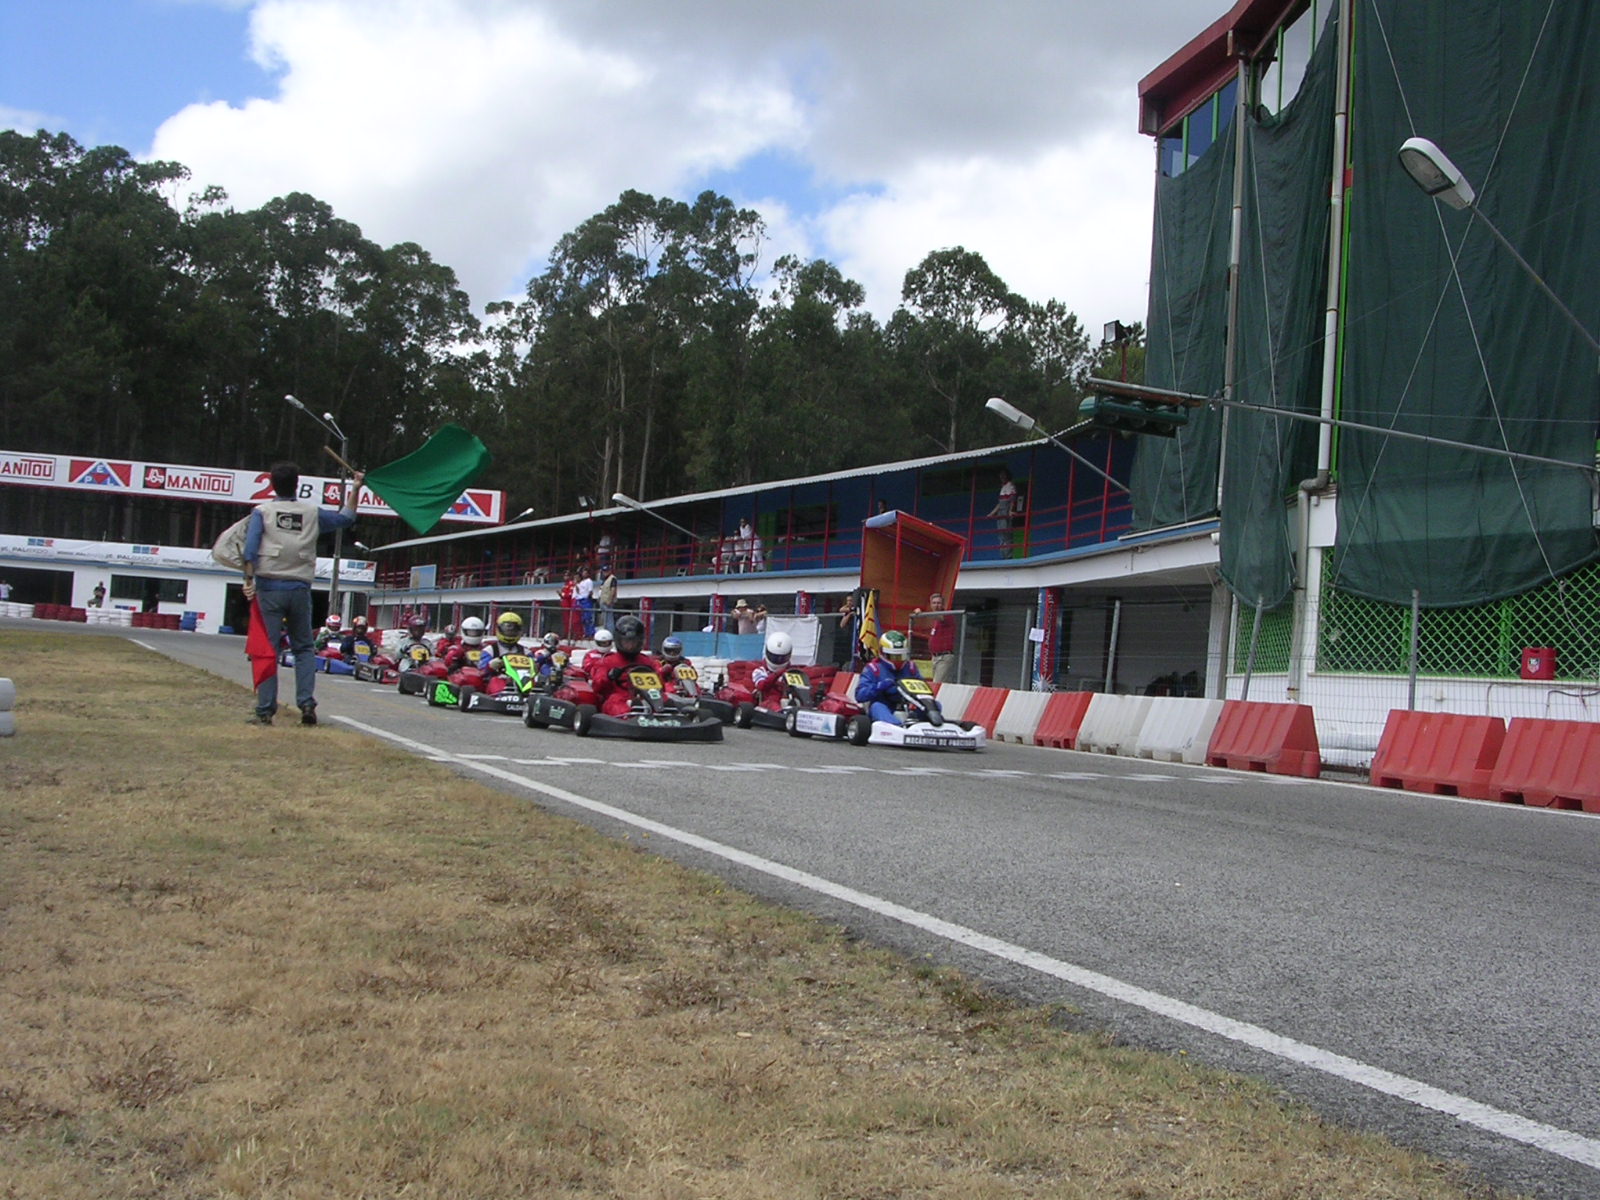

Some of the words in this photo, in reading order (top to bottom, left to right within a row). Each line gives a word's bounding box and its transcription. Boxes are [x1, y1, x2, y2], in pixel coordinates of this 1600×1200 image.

[0, 459, 53, 478] ANITOU
[166, 473, 232, 493] MANITOU
[299, 483, 314, 499] B
[509, 656, 529, 666] 48
[679, 669, 694, 678] 111
[634, 676, 656, 686] 83
[788, 674, 801, 685] 31
